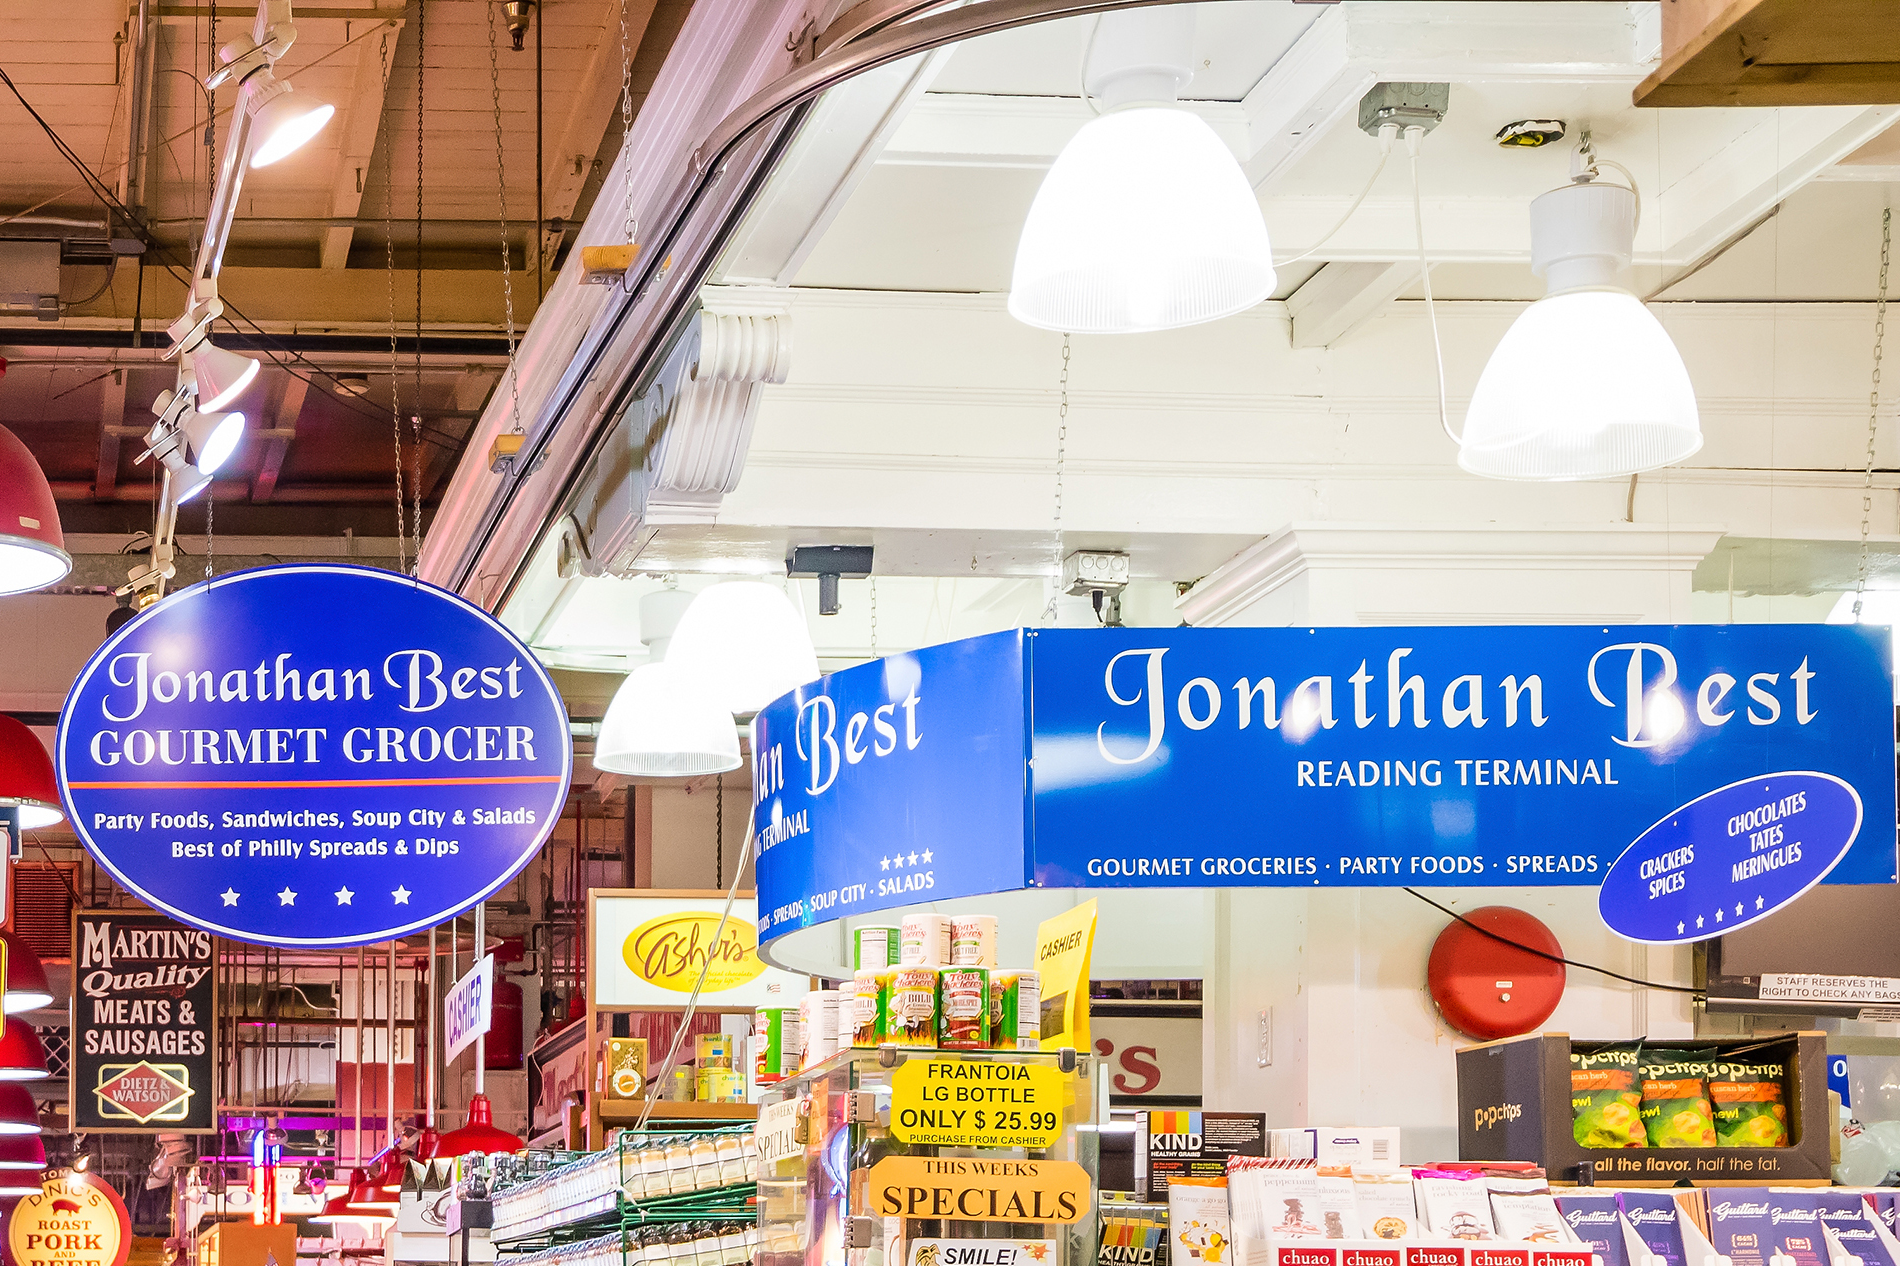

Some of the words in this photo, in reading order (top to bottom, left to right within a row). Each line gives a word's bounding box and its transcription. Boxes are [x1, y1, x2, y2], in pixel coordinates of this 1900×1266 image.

[101, 652, 375, 722] Jonathan
[382, 648, 524, 713] Best
[1096, 646, 1550, 766] Jonathan
[1586, 641, 1820, 749] Best
[90, 727, 328, 767] GOURMET
[342, 725, 537, 763] GROCER
[1297, 759, 1444, 788] READING
[1453, 757, 1620, 786] TERMINAL
[94, 812, 144, 833] Party
[150, 812, 215, 831] Foods,
[221, 809, 345, 831] Sandwiches,
[351, 809, 403, 830] Soup
[407, 808, 446, 830] City
[452, 808, 467, 826] &
[471, 806, 537, 827] Salads
[1726, 792, 1808, 837] CHOCOLATES
[171, 840, 215, 859] Best
[221, 839, 242, 858] of
[248, 838, 303, 860] Philly
[309, 837, 388, 860] Spreads
[394, 838, 409, 855] &
[415, 837, 460, 858] Dips
[1749, 827, 1785, 856] TATES
[1086, 857, 1194, 876] GOURMET
[1201, 856, 1318, 876] GROCERIES
[1339, 856, 1404, 875] PARTY
[1410, 855, 1486, 875] FOODS
[1506, 854, 1598, 874] SPREADS
[1639, 844, 1696, 881] CRACKERS
[1731, 842, 1803, 883] MERINGUES
[1648, 870, 1686, 900] SPICES
[773, 897, 804, 928] SPREADS
[810, 887, 838, 914] SOUP
[839, 881, 867, 905] CITY
[877, 869, 936, 897] SALADS
[80, 921, 212, 968] MARTIN'S
[1040, 930, 1083, 963] CASHIER
[82, 964, 212, 998] Quality
[1761, 986, 1793, 997] RIGHT
[1794, 987, 1810, 998] TO
[1811, 987, 1848, 999] CHECK
[1850, 988, 1872, 999] ANY
[1874, 989, 1900, 1000] BAGS
[1776, 976, 1812, 987] STAFF
[1815, 977, 1866, 988] RESERVES
[1868, 978, 1889, 989] THE
[94, 999, 171, 1025] MEATS
[179, 1000, 196, 1025] &
[449, 973, 483, 1050] CASHIER
[84, 1029, 206, 1056] SAUSAGES
[120, 1077, 158, 1090] DIETZ
[159, 1077, 170, 1089] &
[927, 1063, 1031, 1082] FRANTOIA
[112, 1089, 171, 1103] WATSON
[922, 1087, 950, 1104] LG
[956, 1086, 1035, 1104] BOTTLE
[899, 1109, 967, 1130] ONLY
[974, 1108, 987, 1131] $
[995, 1111, 1057, 1132] 25.99
[909, 1134, 967, 1145] PURCHASE
[969, 1135, 999, 1145] FROM
[1000, 1135, 1047, 1146] CASHIER
[1149, 1133, 1203, 1152] KIND
[923, 1160, 968, 1175] THIS
[973, 1162, 1039, 1178] WEEKS
[1594, 1157, 1614, 1172] all
[1617, 1157, 1642, 1172] the
[1646, 1156, 1692, 1172] flavor.
[1696, 1156, 1725, 1171] half
[1729, 1157, 1754, 1172] the
[1757, 1156, 1781, 1172] fat.
[882, 1186, 1077, 1220] SPECIALS
[38, 1220, 92, 1230] ROAST
[26, 1233, 103, 1250] PORK
[54, 1250, 76, 1259] AND
[943, 1247, 1018, 1266] SMILE!
[1282, 1250, 1331, 1266] chuao
